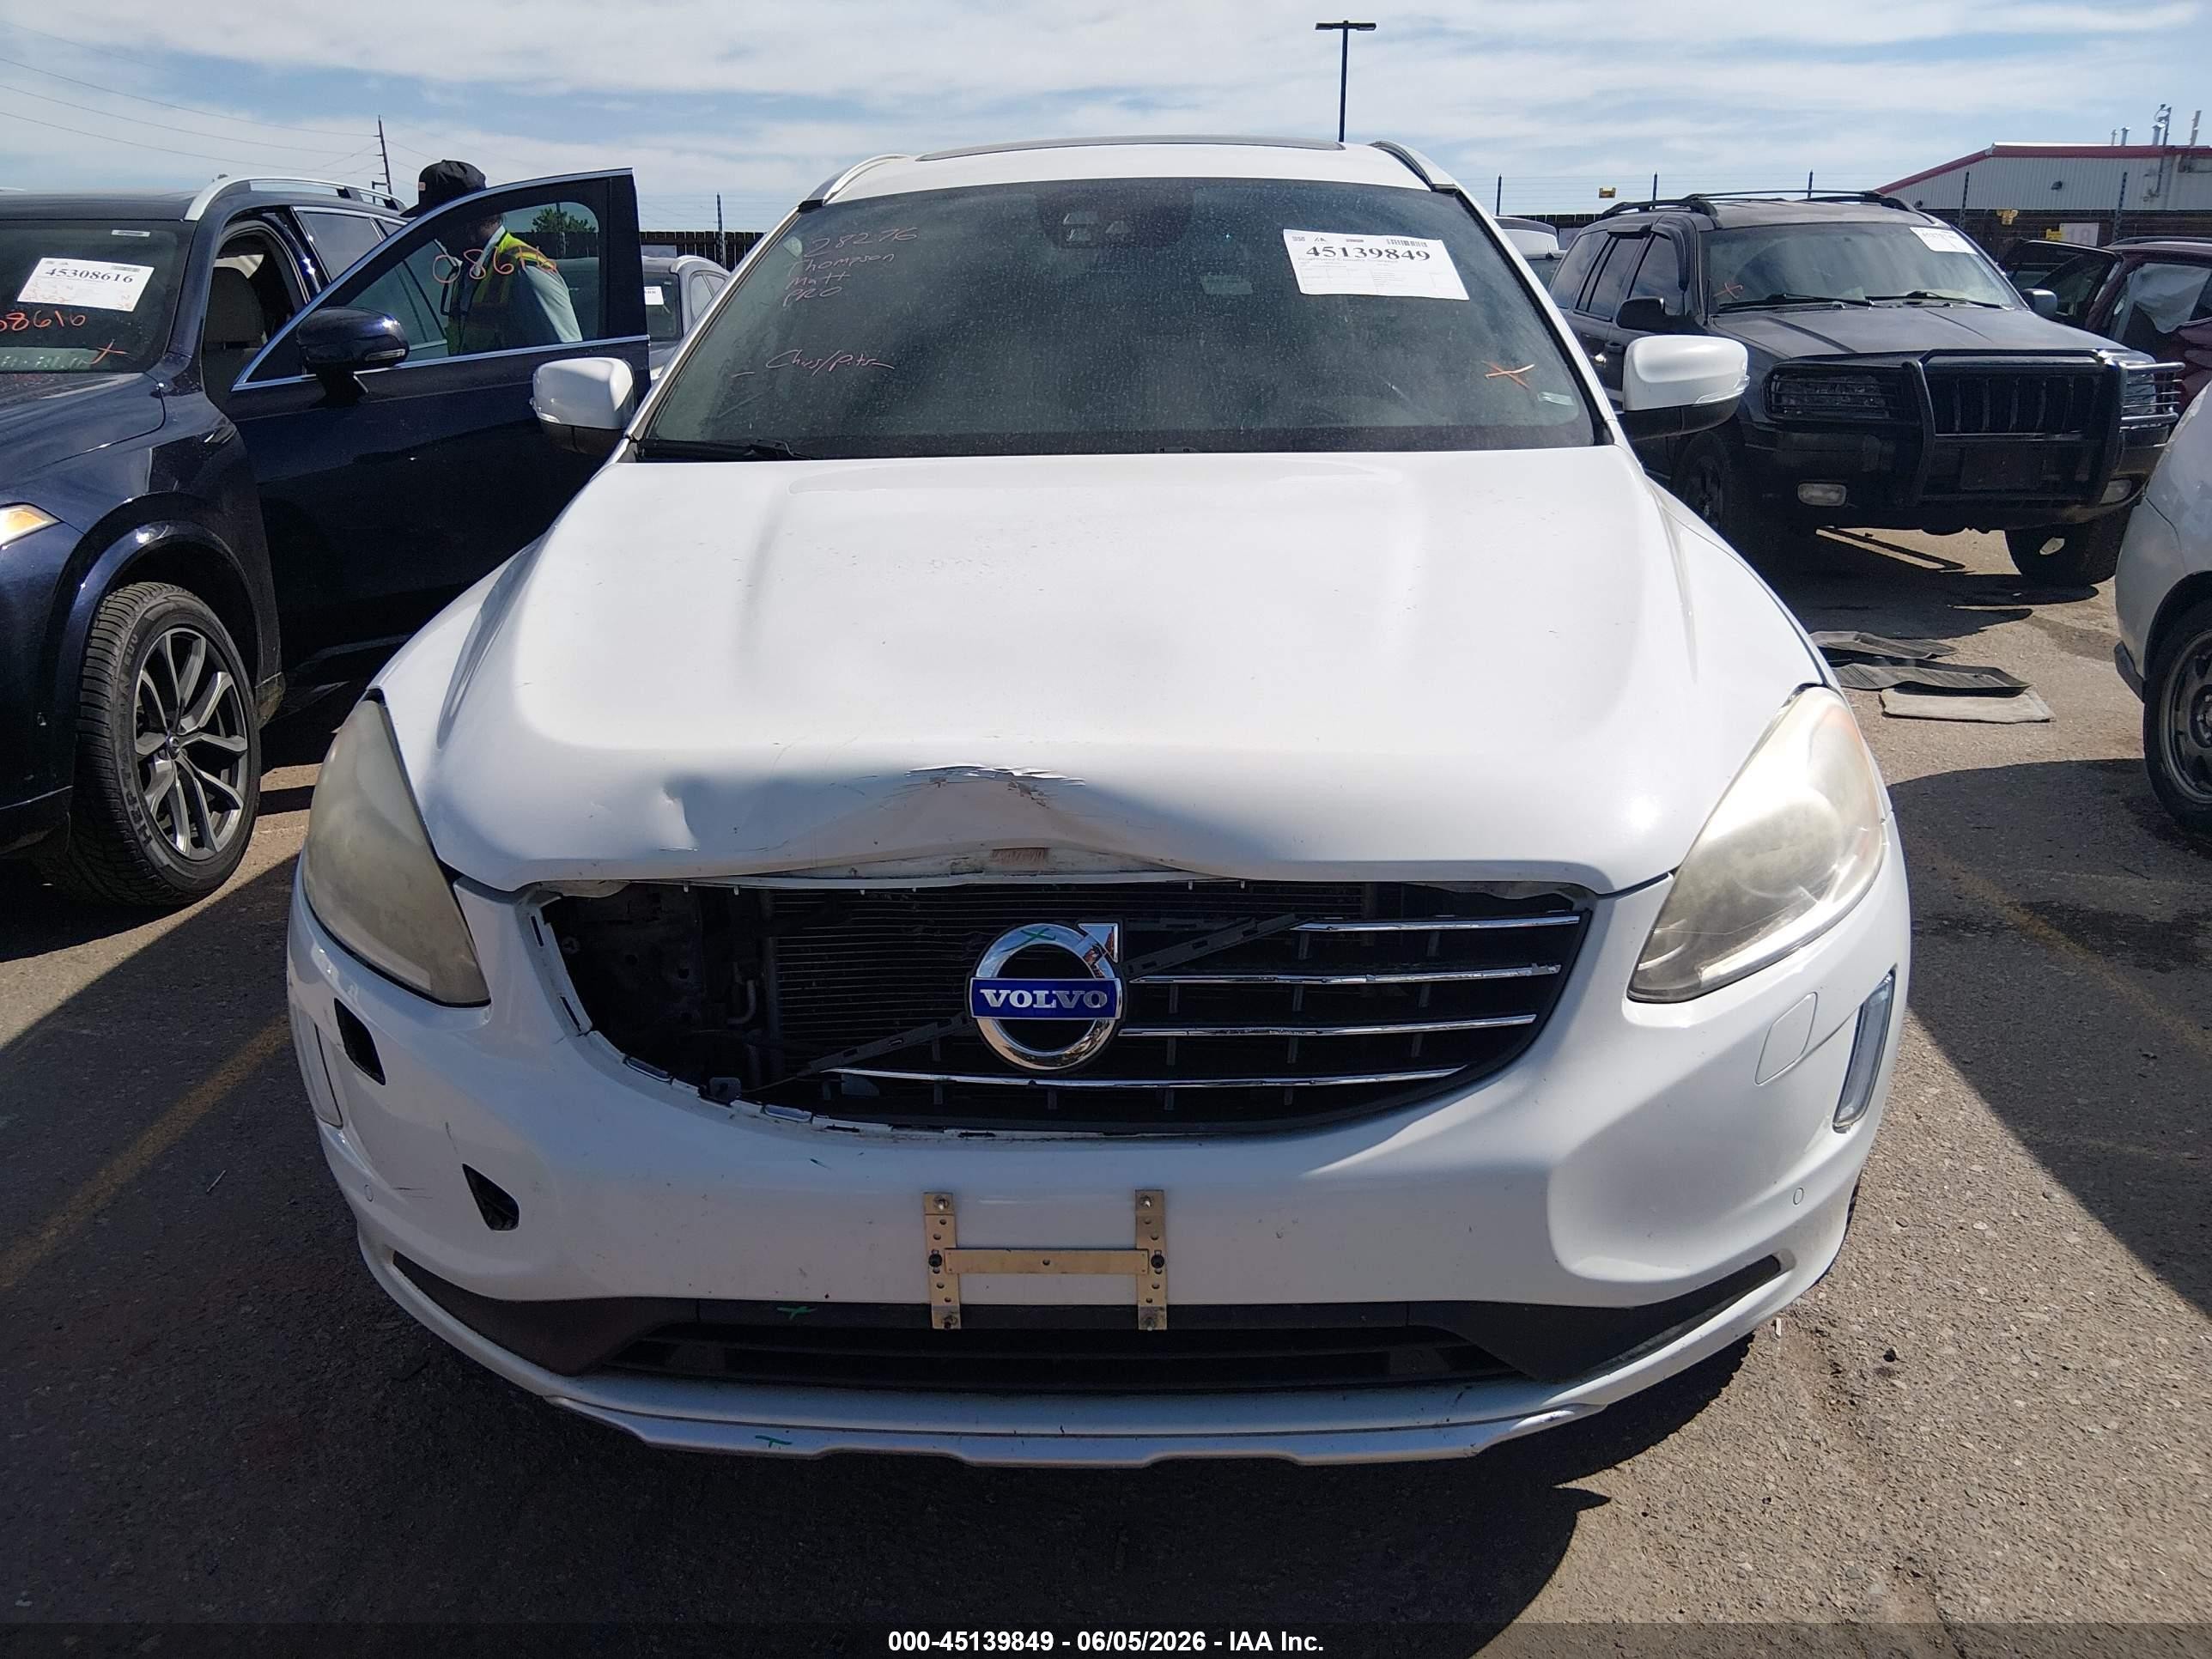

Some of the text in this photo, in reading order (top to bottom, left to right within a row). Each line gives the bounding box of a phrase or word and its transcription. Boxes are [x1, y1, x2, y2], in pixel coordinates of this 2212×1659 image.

[804, 228, 918, 258] 28276
[1306, 246, 1431, 261] 45139849
[788, 253, 895, 277] Thompson
[46, 268, 134, 284] 45308616
[785, 270, 851, 290] Matt
[979, 989, 1108, 1009] VOLVO
